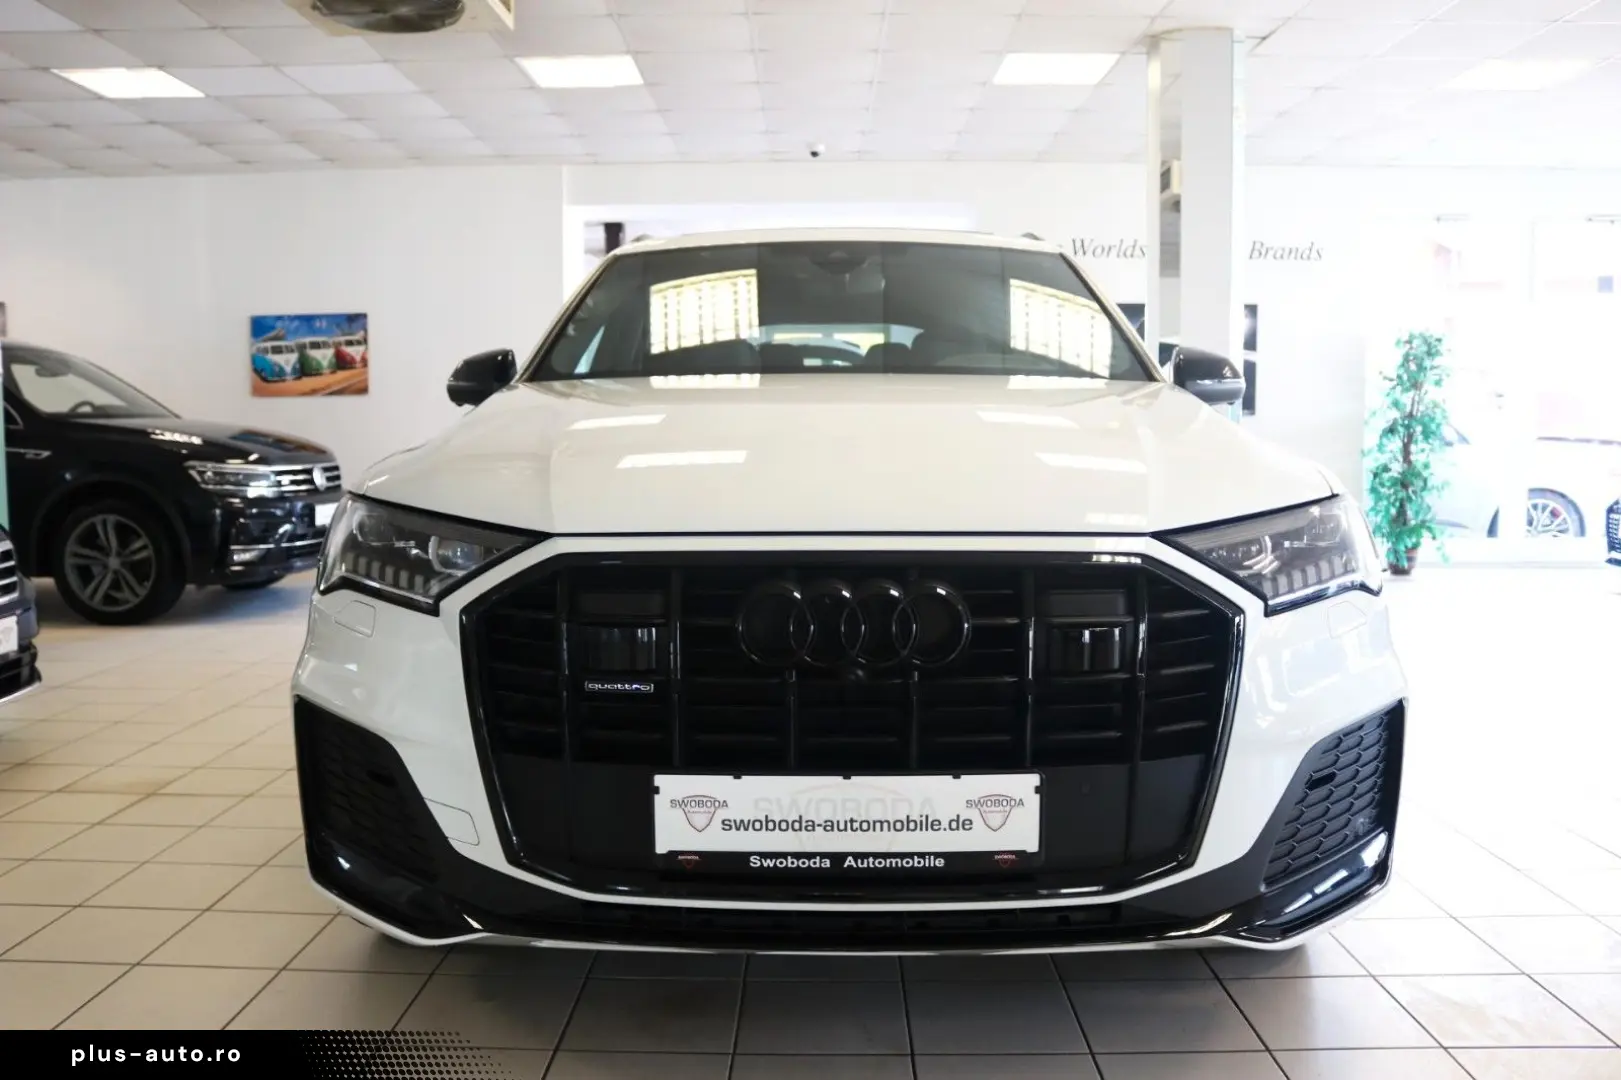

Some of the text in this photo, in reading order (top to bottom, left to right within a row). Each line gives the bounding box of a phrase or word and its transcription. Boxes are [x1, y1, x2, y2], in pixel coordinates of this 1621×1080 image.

[1070, 238, 1323, 261] Worlds Brands
[588, 682, 650, 692] quattro
[670, 799, 729, 809] SWOBODA
[965, 798, 1025, 809] SWOBODA
[720, 814, 973, 833] swoboda-automobile.de
[750, 855, 945, 868] Swoboda Automobile
